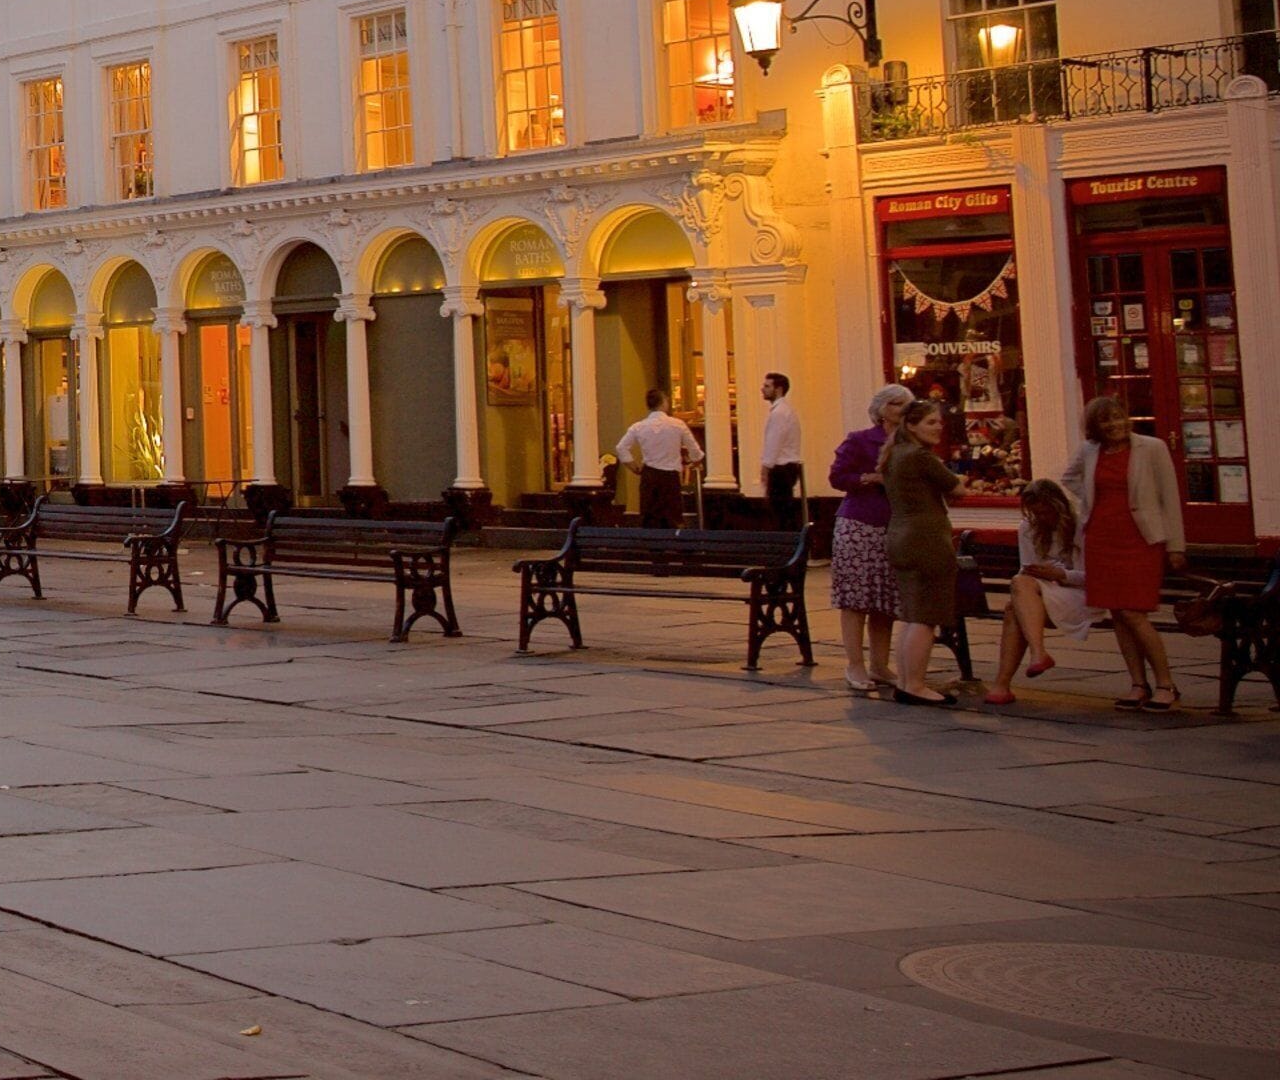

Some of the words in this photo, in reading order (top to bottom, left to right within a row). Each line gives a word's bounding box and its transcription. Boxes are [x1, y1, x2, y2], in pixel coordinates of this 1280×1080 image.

[1090, 178, 1143, 195] Tourist
[1146, 175, 1198, 189] Centre
[888, 200, 932, 213] Roman
[935, 195, 961, 211] City
[965, 192, 998, 207] Gifts
[510, 238, 554, 252] ROMAN
[515, 251, 552, 265] BATHS
[922, 340, 1002, 356] SOUVENIRS
